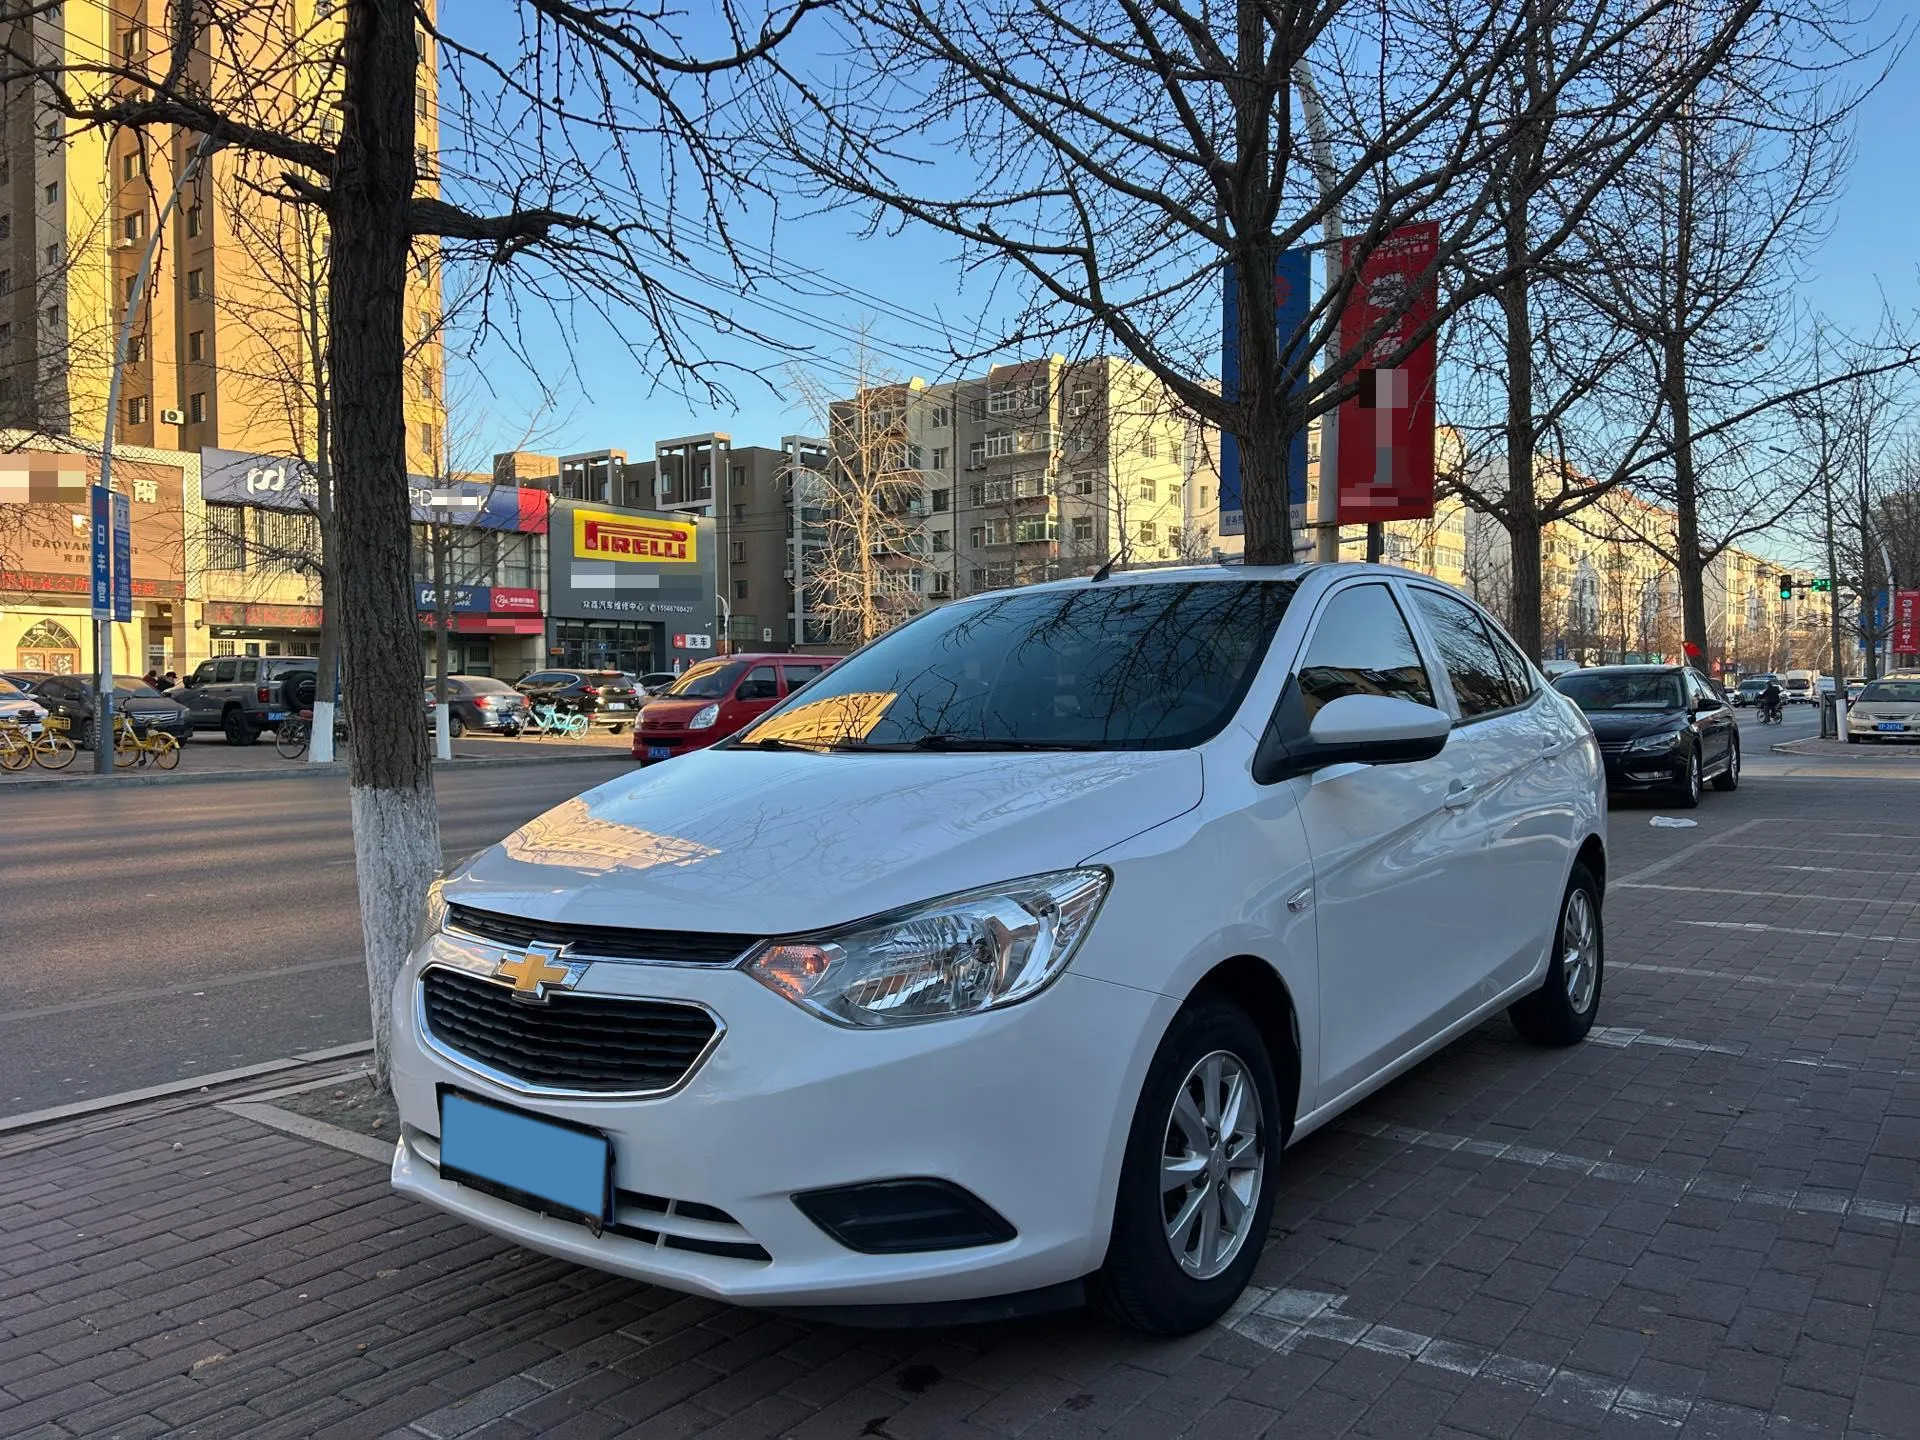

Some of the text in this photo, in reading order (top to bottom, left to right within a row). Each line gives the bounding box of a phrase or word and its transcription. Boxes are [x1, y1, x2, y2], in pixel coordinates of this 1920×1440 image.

[584, 519, 688, 560] PIRELLI
[97, 524, 107, 603] 日丰管
[689, 636, 708, 647] 洗车
